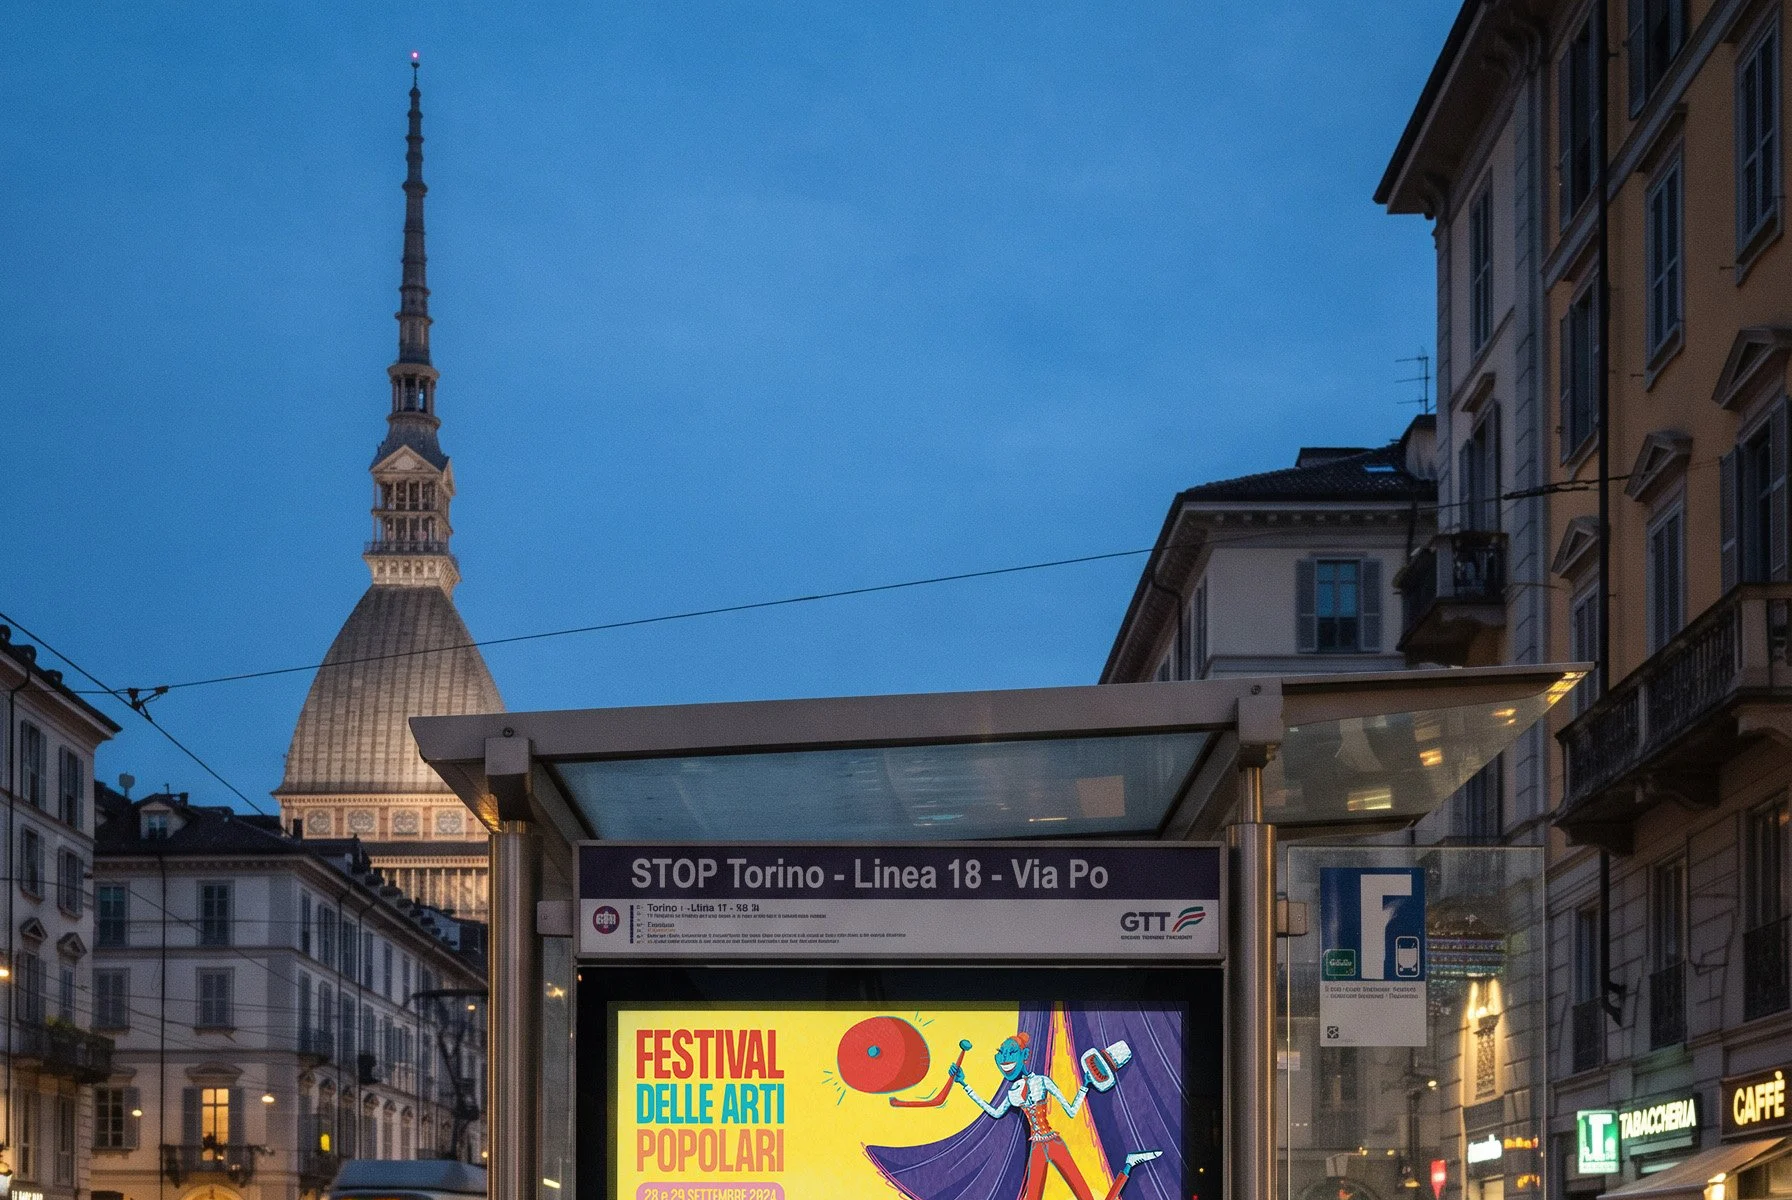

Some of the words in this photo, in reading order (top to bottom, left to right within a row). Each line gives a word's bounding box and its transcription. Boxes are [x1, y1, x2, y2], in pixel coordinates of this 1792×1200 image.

[631, 858, 718, 889] STOP
[726, 858, 825, 889] Torino
[855, 858, 937, 889] Linea
[948, 858, 982, 889] 18
[1011, 858, 1059, 889] Via
[1069, 858, 1109, 889] Po
[647, 903, 678, 912] Torino
[1120, 911, 1171, 932] GTT
[636, 1029, 784, 1079] FESTIVAL
[636, 1083, 714, 1124] DELLE
[721, 1083, 785, 1124] ARTI
[1619, 1098, 1697, 1140] TABACCHERIA
[636, 1128, 785, 1172] POPOLARI
